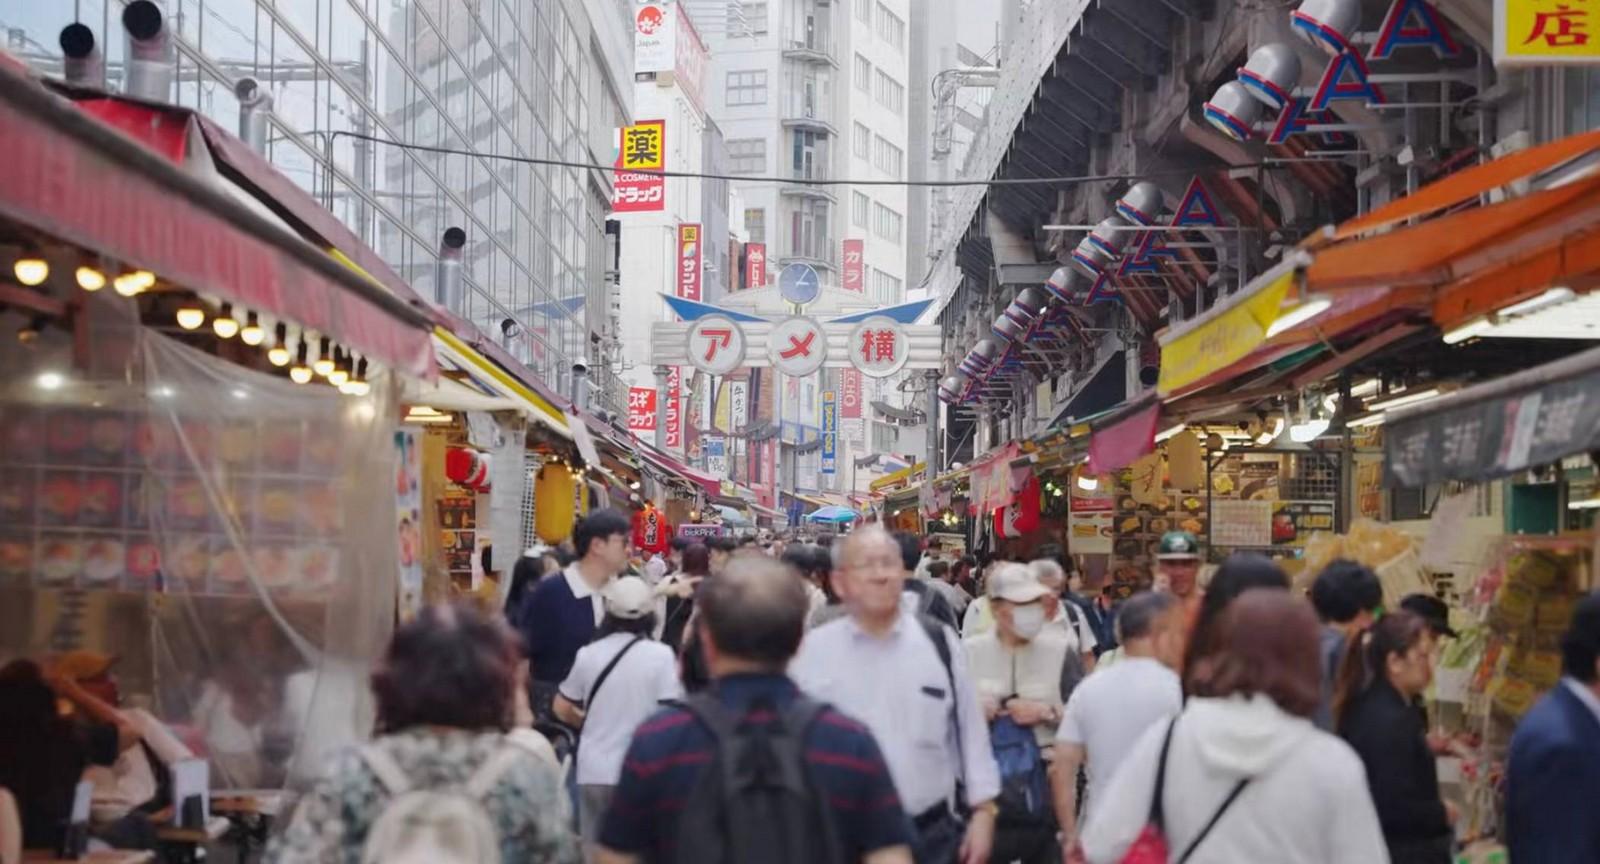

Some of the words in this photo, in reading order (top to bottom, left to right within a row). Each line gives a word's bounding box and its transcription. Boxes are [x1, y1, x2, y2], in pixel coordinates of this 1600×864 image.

[1522, 4, 1590, 47] 店
[626, 128, 658, 164] 薬
[845, 250, 861, 292] カラ
[700, 329, 897, 363] アメ横
[629, 391, 650, 408] スギ
